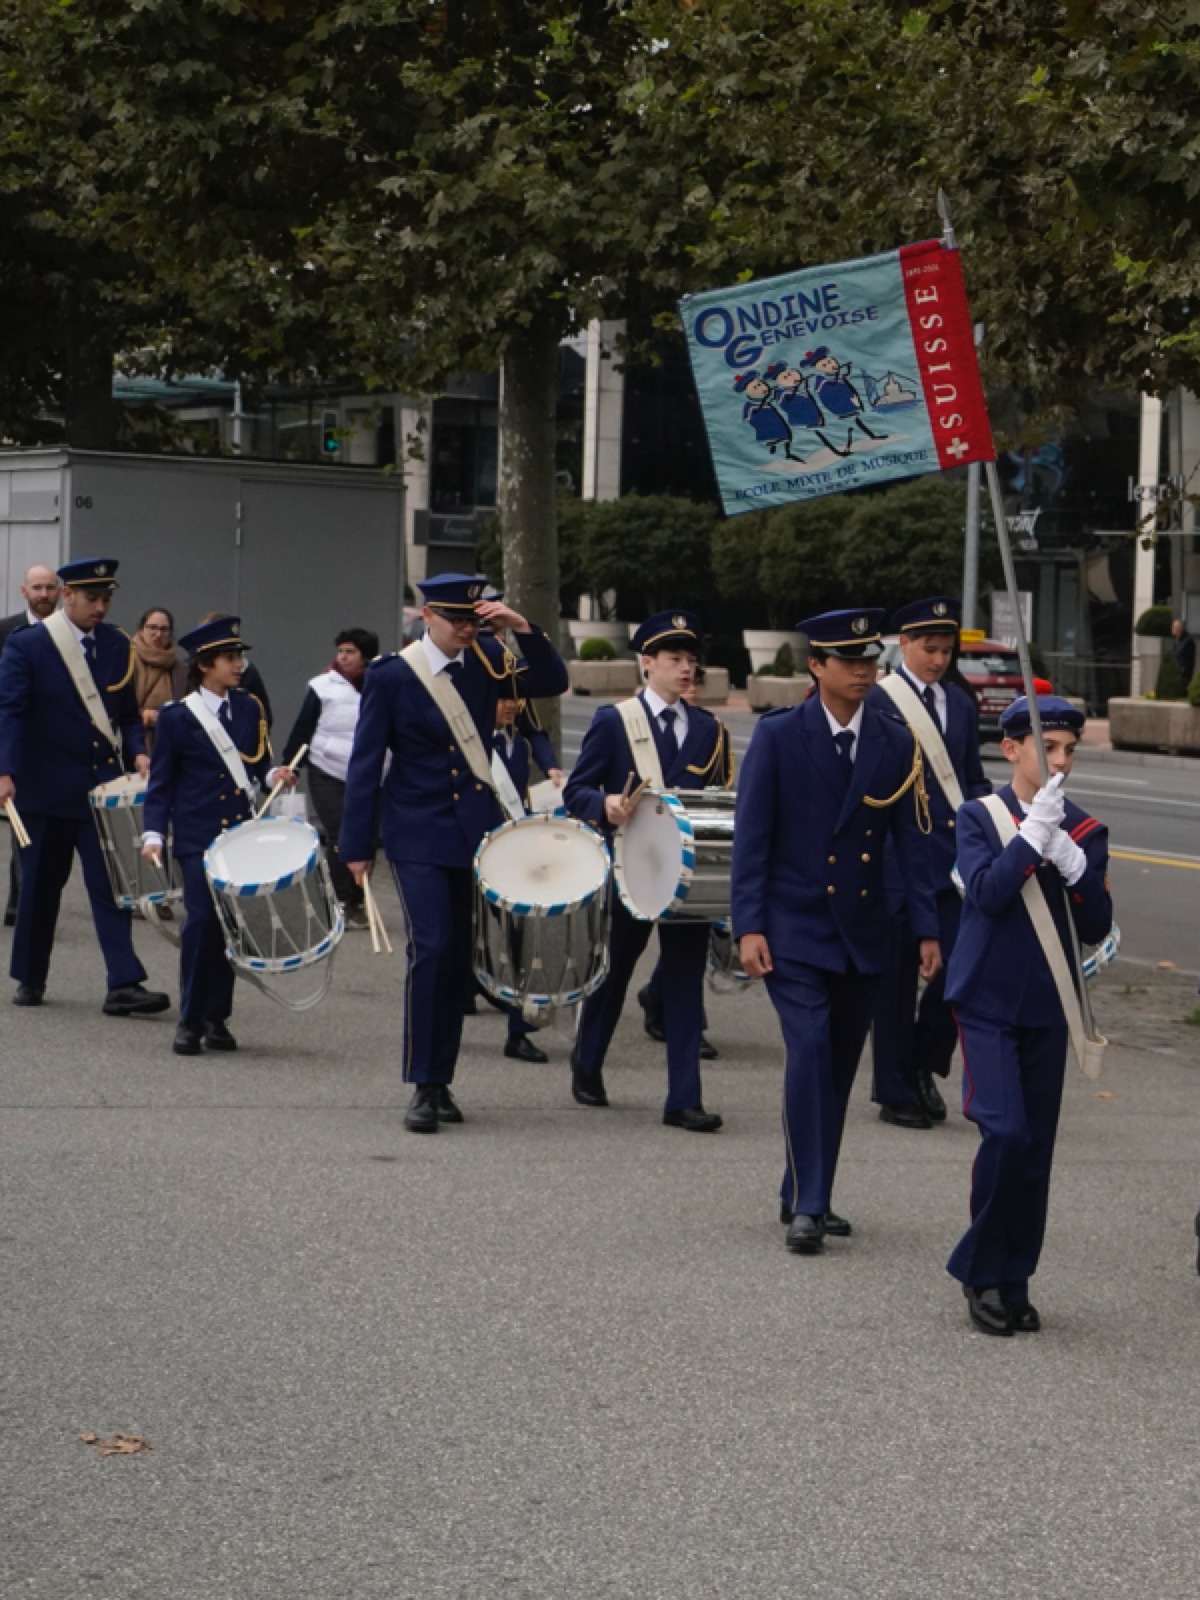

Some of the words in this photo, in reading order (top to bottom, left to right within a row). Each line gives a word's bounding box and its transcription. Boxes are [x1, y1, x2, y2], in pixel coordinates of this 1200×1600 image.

[694, 283, 840, 348] ONDINE
[724, 305, 879, 368] GENEVOISE
[914, 285, 963, 429] SUISSE
[85, 502, 112, 523] 06
